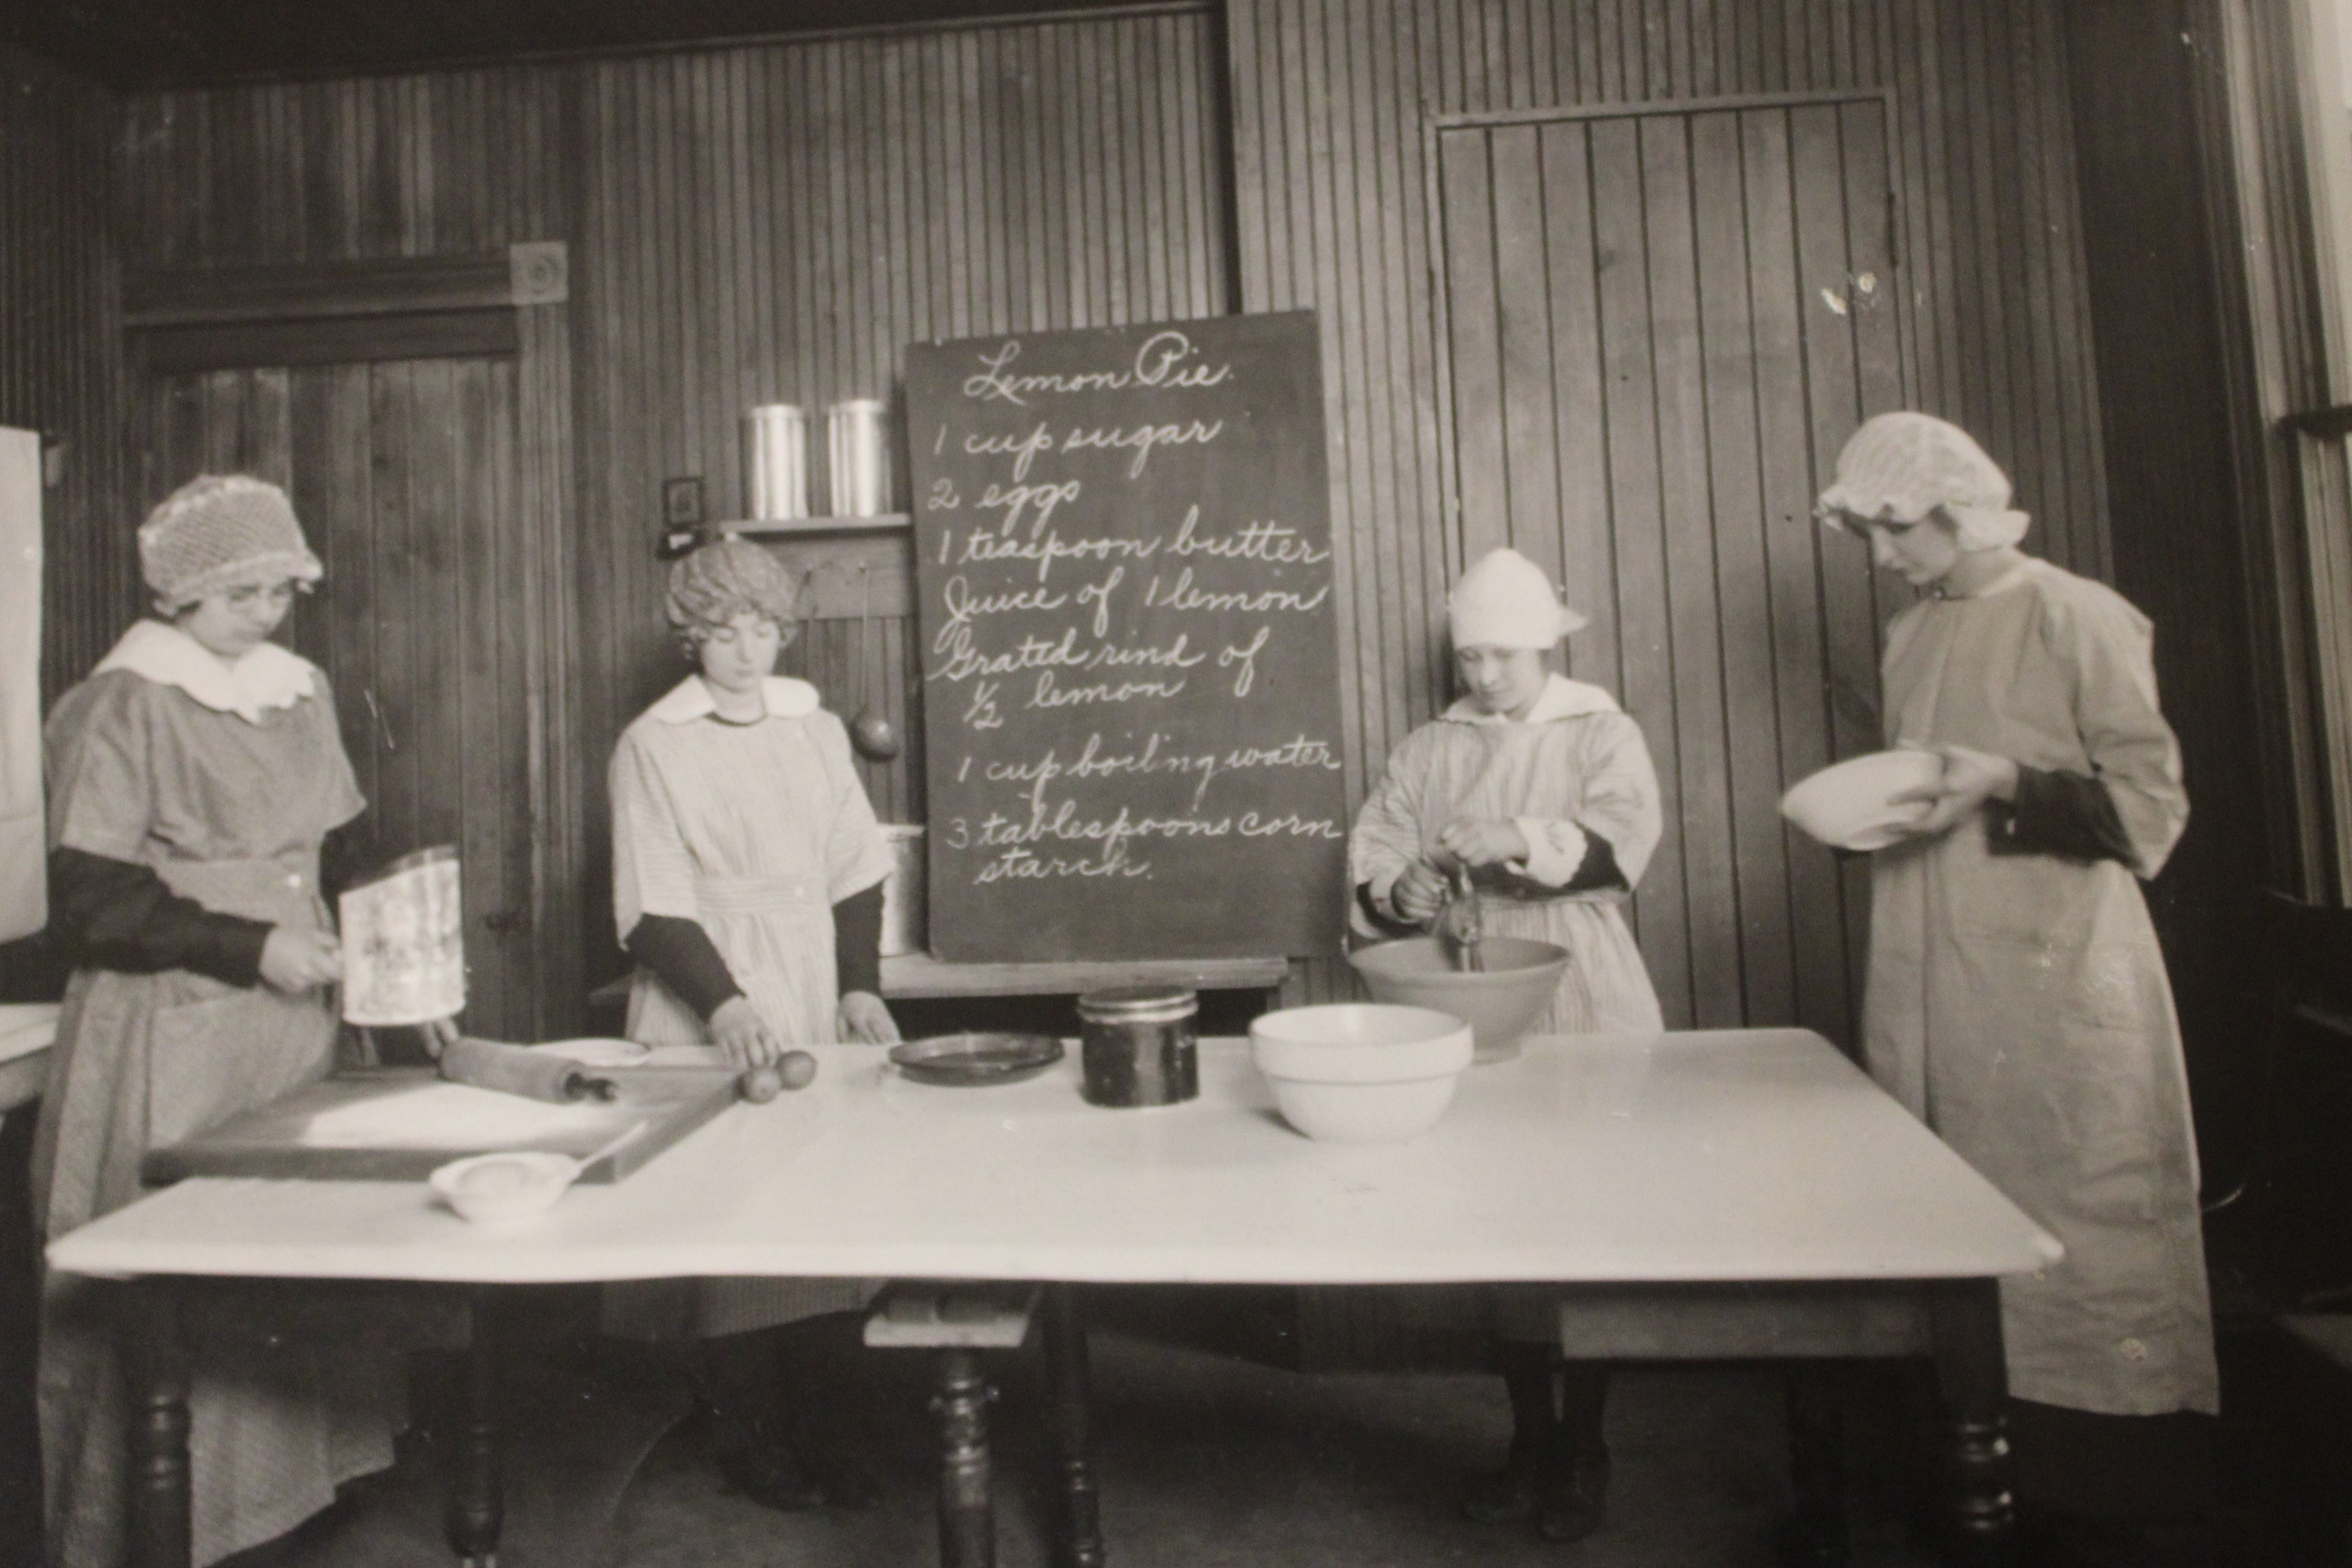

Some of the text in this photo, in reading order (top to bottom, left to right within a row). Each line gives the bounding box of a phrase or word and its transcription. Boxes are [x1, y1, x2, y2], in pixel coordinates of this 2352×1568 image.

[964, 340, 1128, 405] Lemon
[934, 420, 1223, 482] 1 cup sugar
[928, 479, 1081, 539] 2 eggs
[938, 504, 1333, 581] 1 teaspoon butter
[934, 564, 1329, 654] Juice of 1 lemon
[926, 626, 1270, 697] Grated rind of
[1025, 671, 1185, 709] lemon
[958, 756, 971, 782] 1
[985, 749, 1062, 810] cup
[1225, 734, 1342, 770] water
[946, 800, 1343, 863] 3 tablespoons corn
